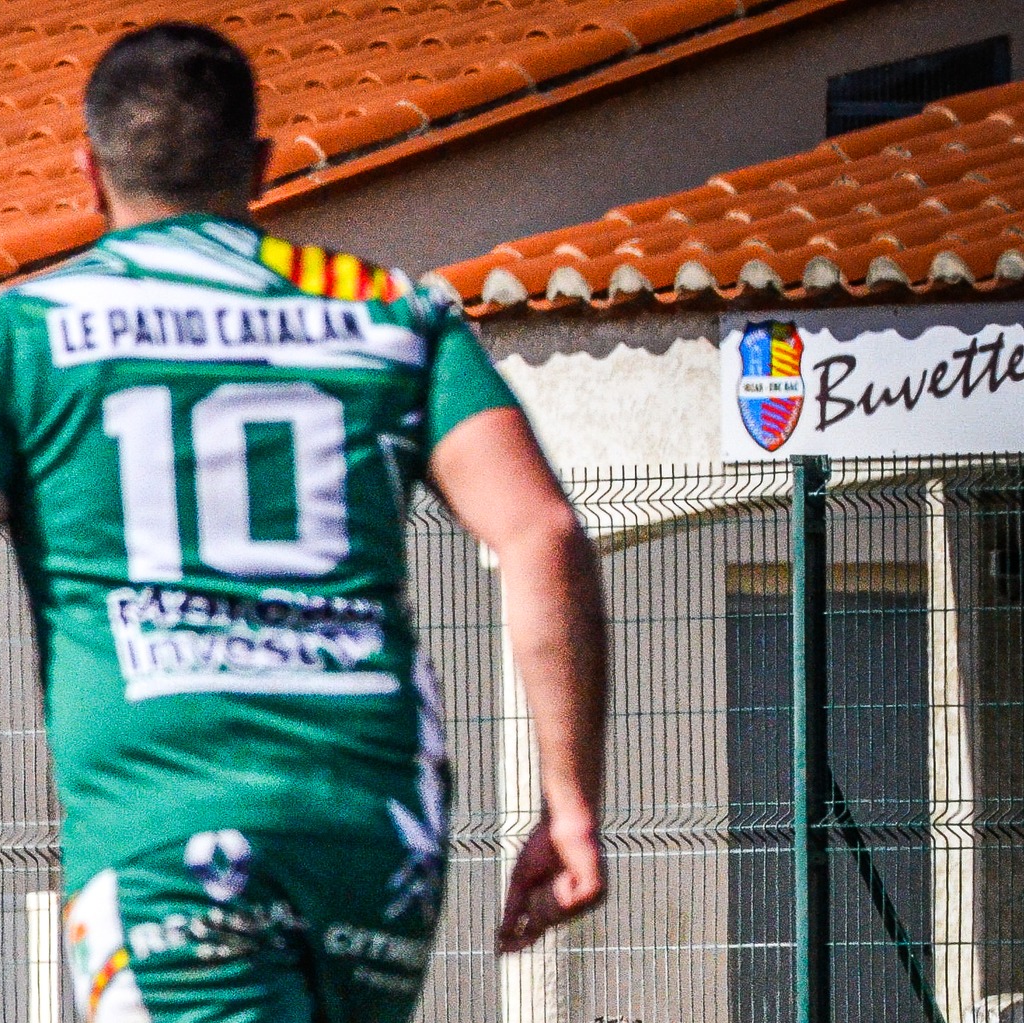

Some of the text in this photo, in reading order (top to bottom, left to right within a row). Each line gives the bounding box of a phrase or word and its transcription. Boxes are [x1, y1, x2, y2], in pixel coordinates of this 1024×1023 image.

[61, 311, 96, 352] LE
[108, 306, 208, 348] PATIO
[813, 332, 1024, 432] Buvette
[103, 382, 350, 583] 10
